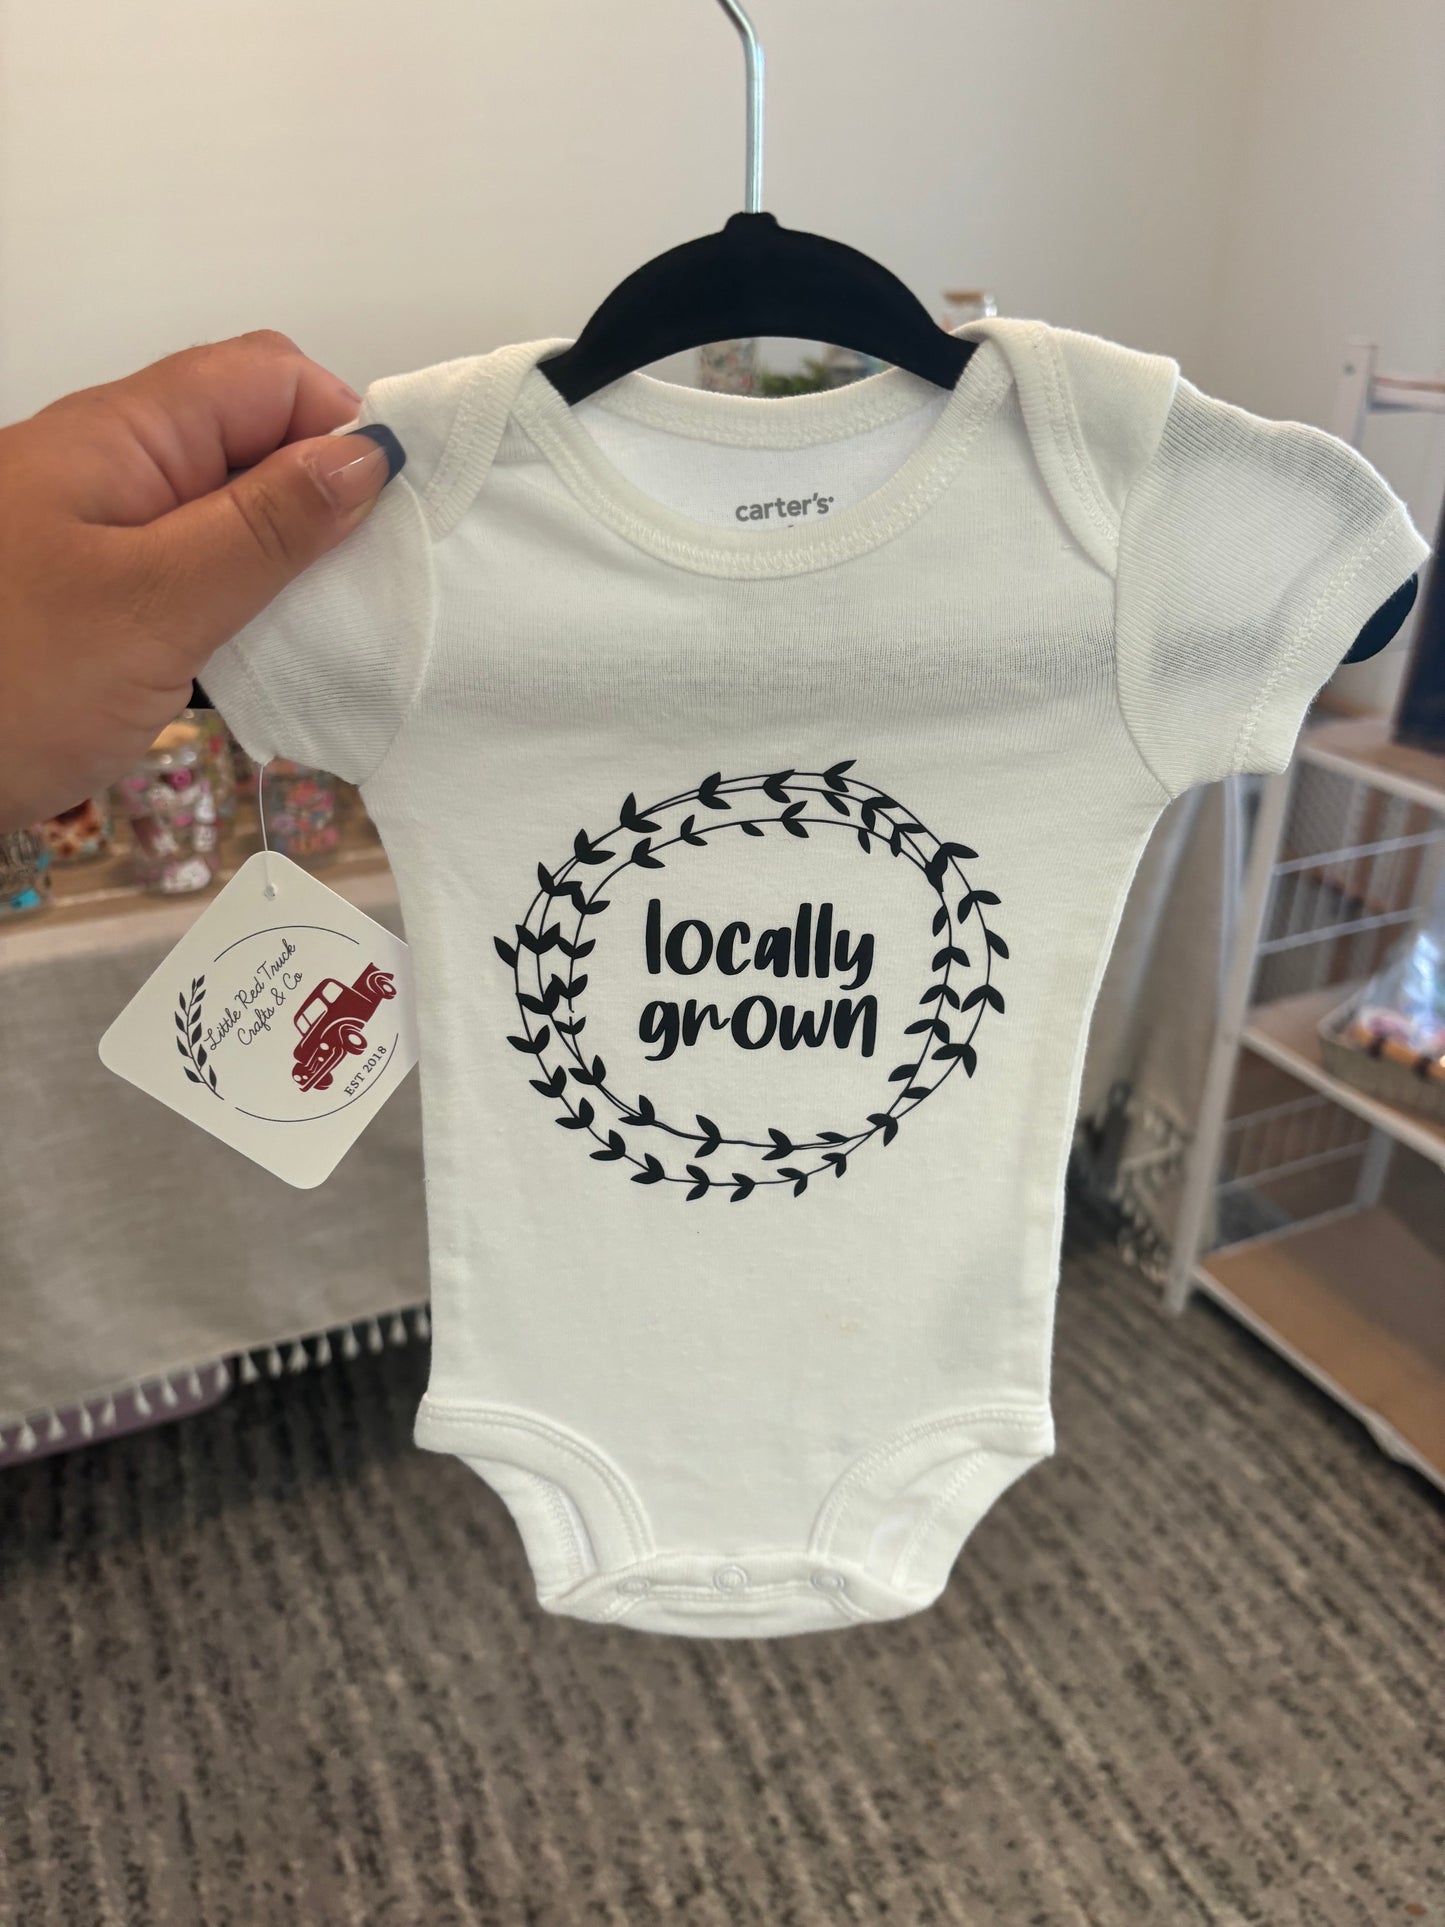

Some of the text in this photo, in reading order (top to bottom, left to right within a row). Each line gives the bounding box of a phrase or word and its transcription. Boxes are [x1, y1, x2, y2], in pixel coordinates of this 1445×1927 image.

[735, 492, 829, 522] carter's
[645, 898, 875, 991] locally
[203, 938, 296, 1051] Little Red Truck
[237, 972, 303, 1046] Crafts & Co
[639, 994, 878, 1062] grown
[343, 1045, 388, 1097] EST 2018
